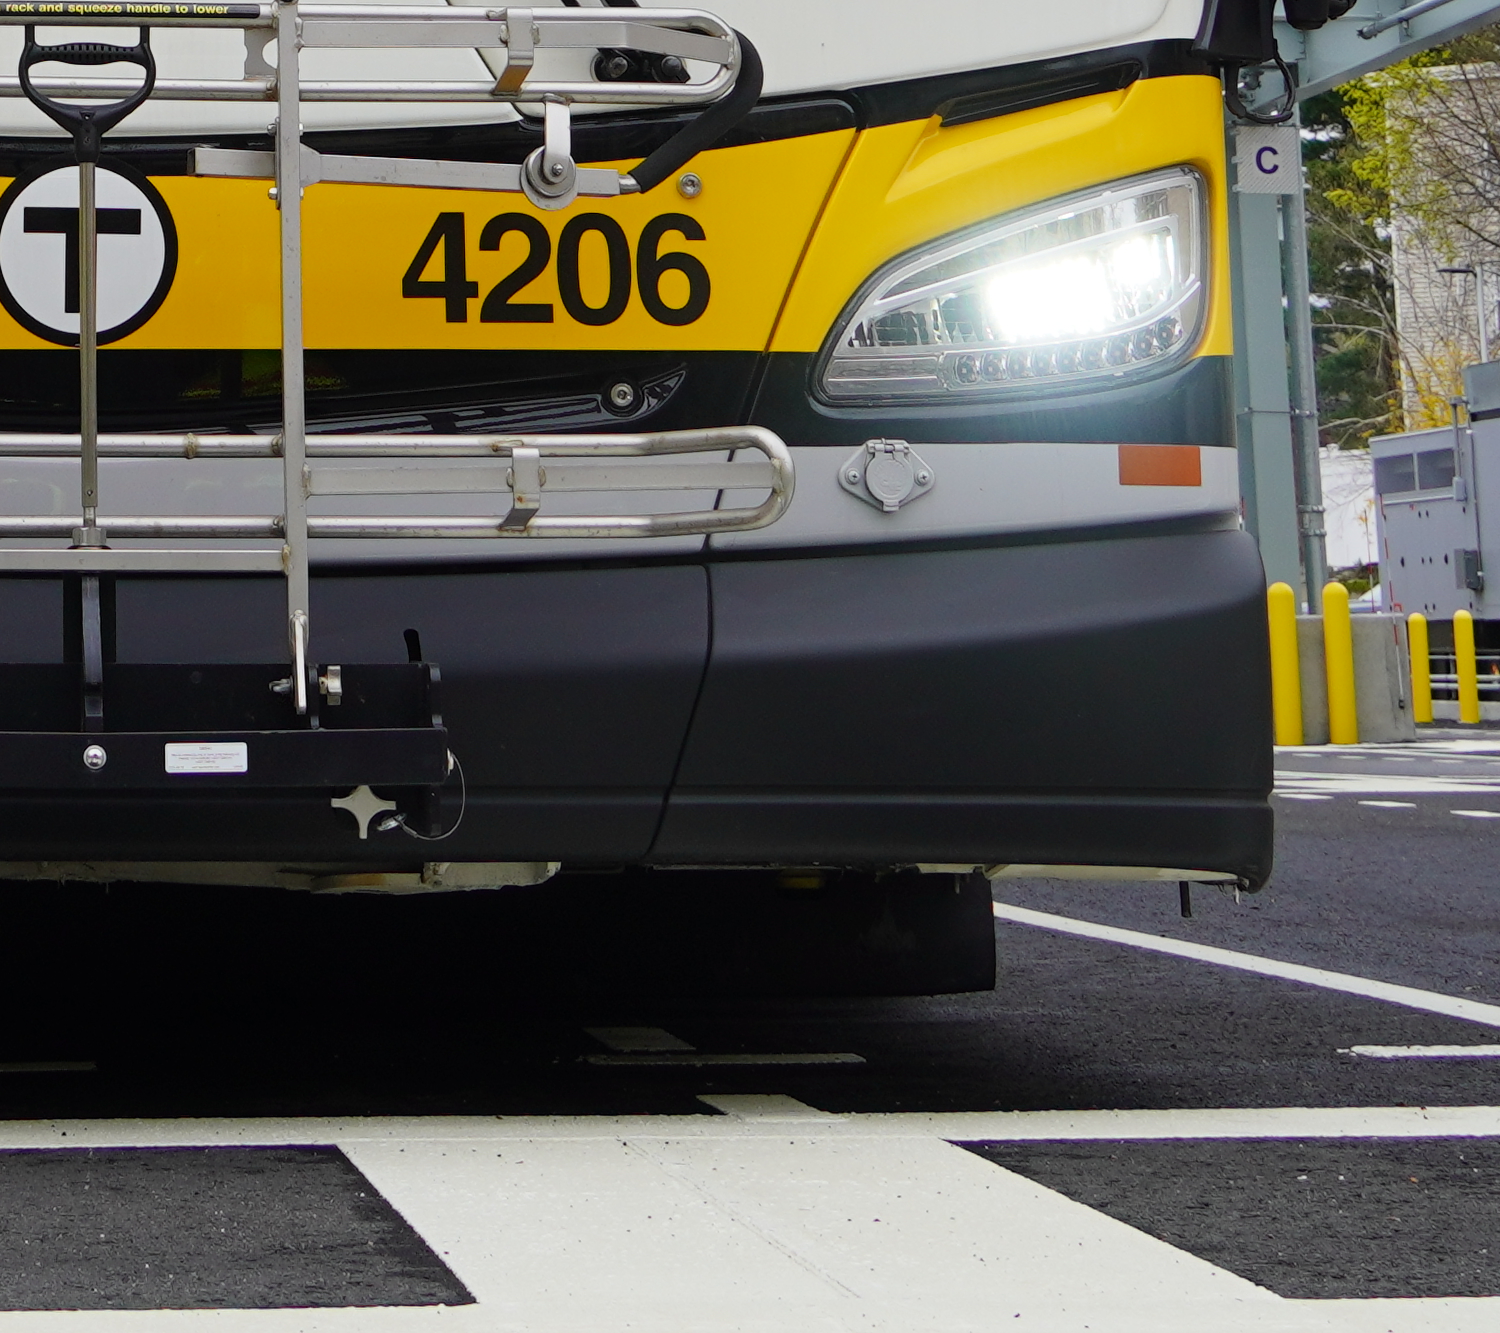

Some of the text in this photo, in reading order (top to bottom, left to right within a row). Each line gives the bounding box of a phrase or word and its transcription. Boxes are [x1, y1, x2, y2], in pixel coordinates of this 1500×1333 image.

[6, 3, 35, 13] rack
[39, 3, 63, 13] and
[67, 4, 122, 15] squeeze
[126, 3, 171, 14] handle
[175, 3, 188, 14] to
[193, 3, 229, 15] lower
[1255, 145, 1279, 175] C
[402, 211, 711, 326] 4206
